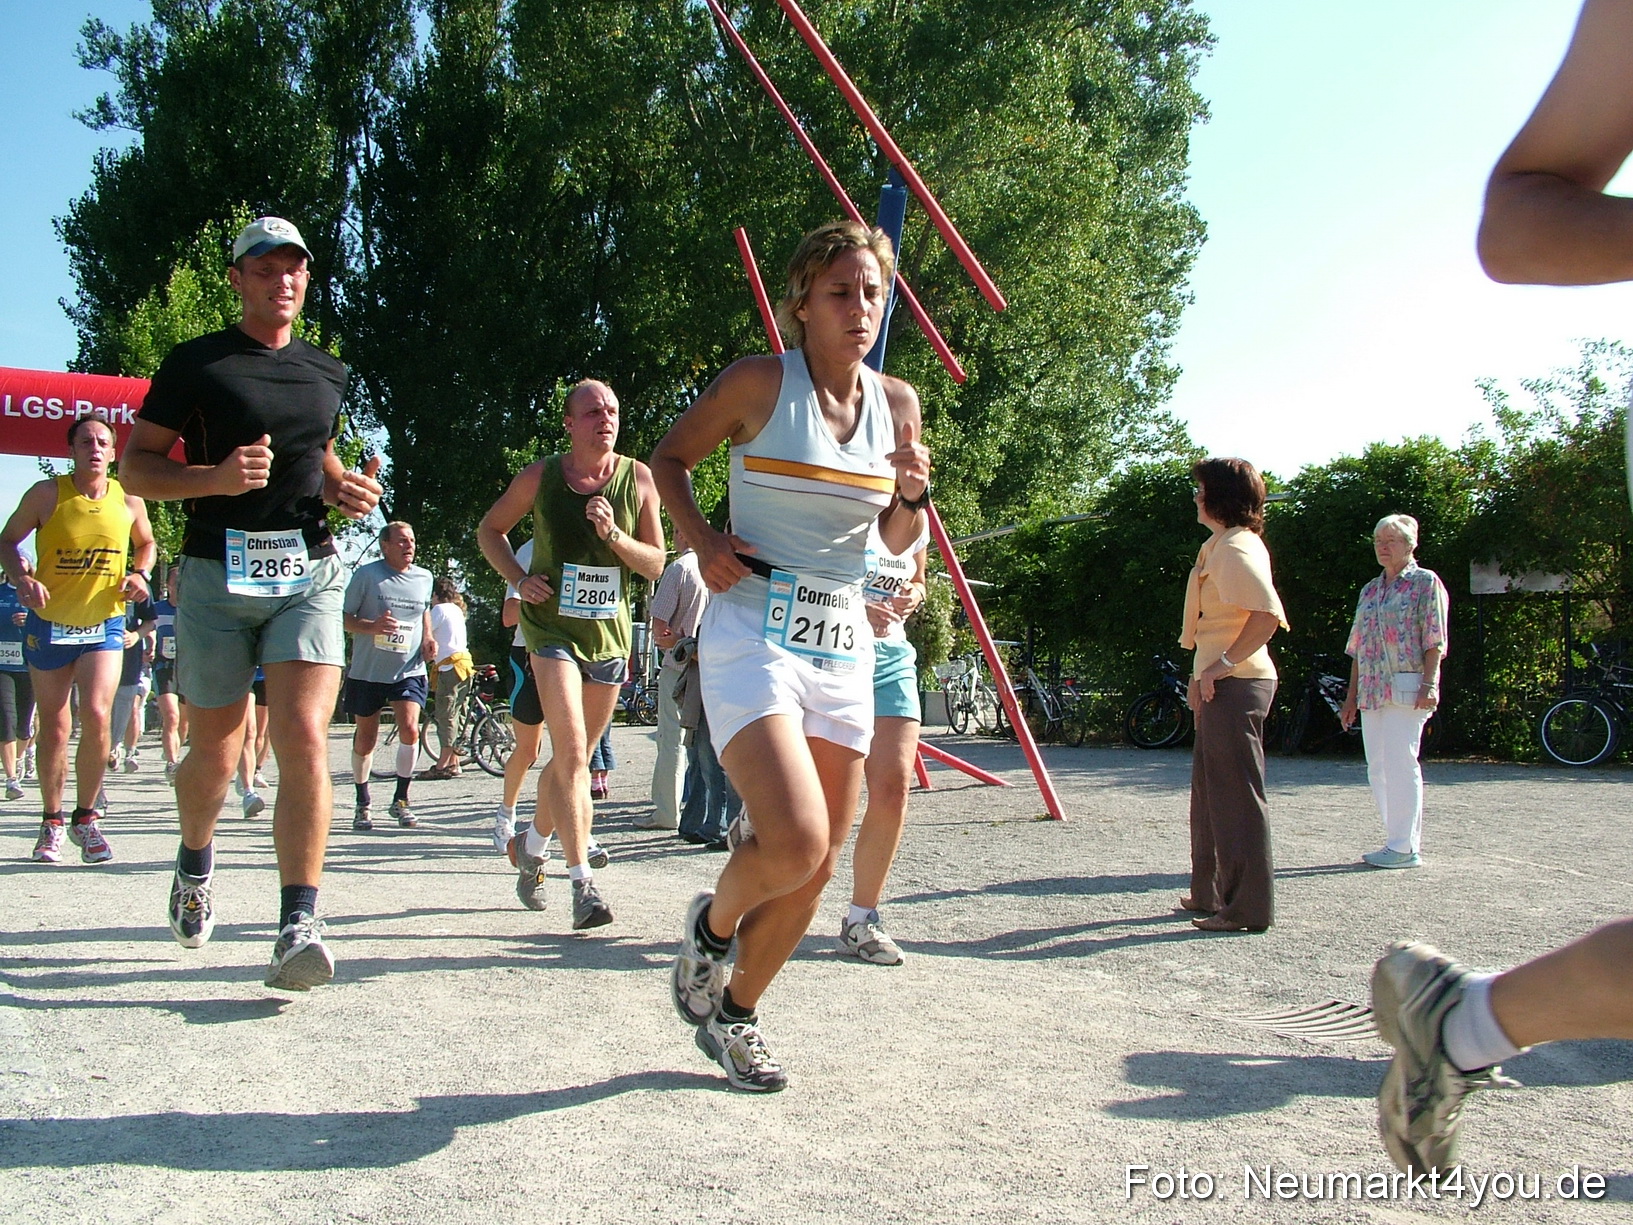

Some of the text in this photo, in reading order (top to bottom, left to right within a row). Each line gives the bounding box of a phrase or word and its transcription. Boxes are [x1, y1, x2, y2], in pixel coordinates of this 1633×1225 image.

[4, 395, 136, 425] LGS-Park
[247, 537, 299, 550] Christian
[231, 555, 305, 579] B 2865
[879, 556, 907, 570] Claudia
[577, 571, 610, 583] Markus
[866, 570, 909, 592] C 208
[564, 583, 616, 605] C 2804
[796, 585, 850, 610] Cornelia
[65, 623, 101, 636] 2567
[771, 606, 855, 651] C 2113
